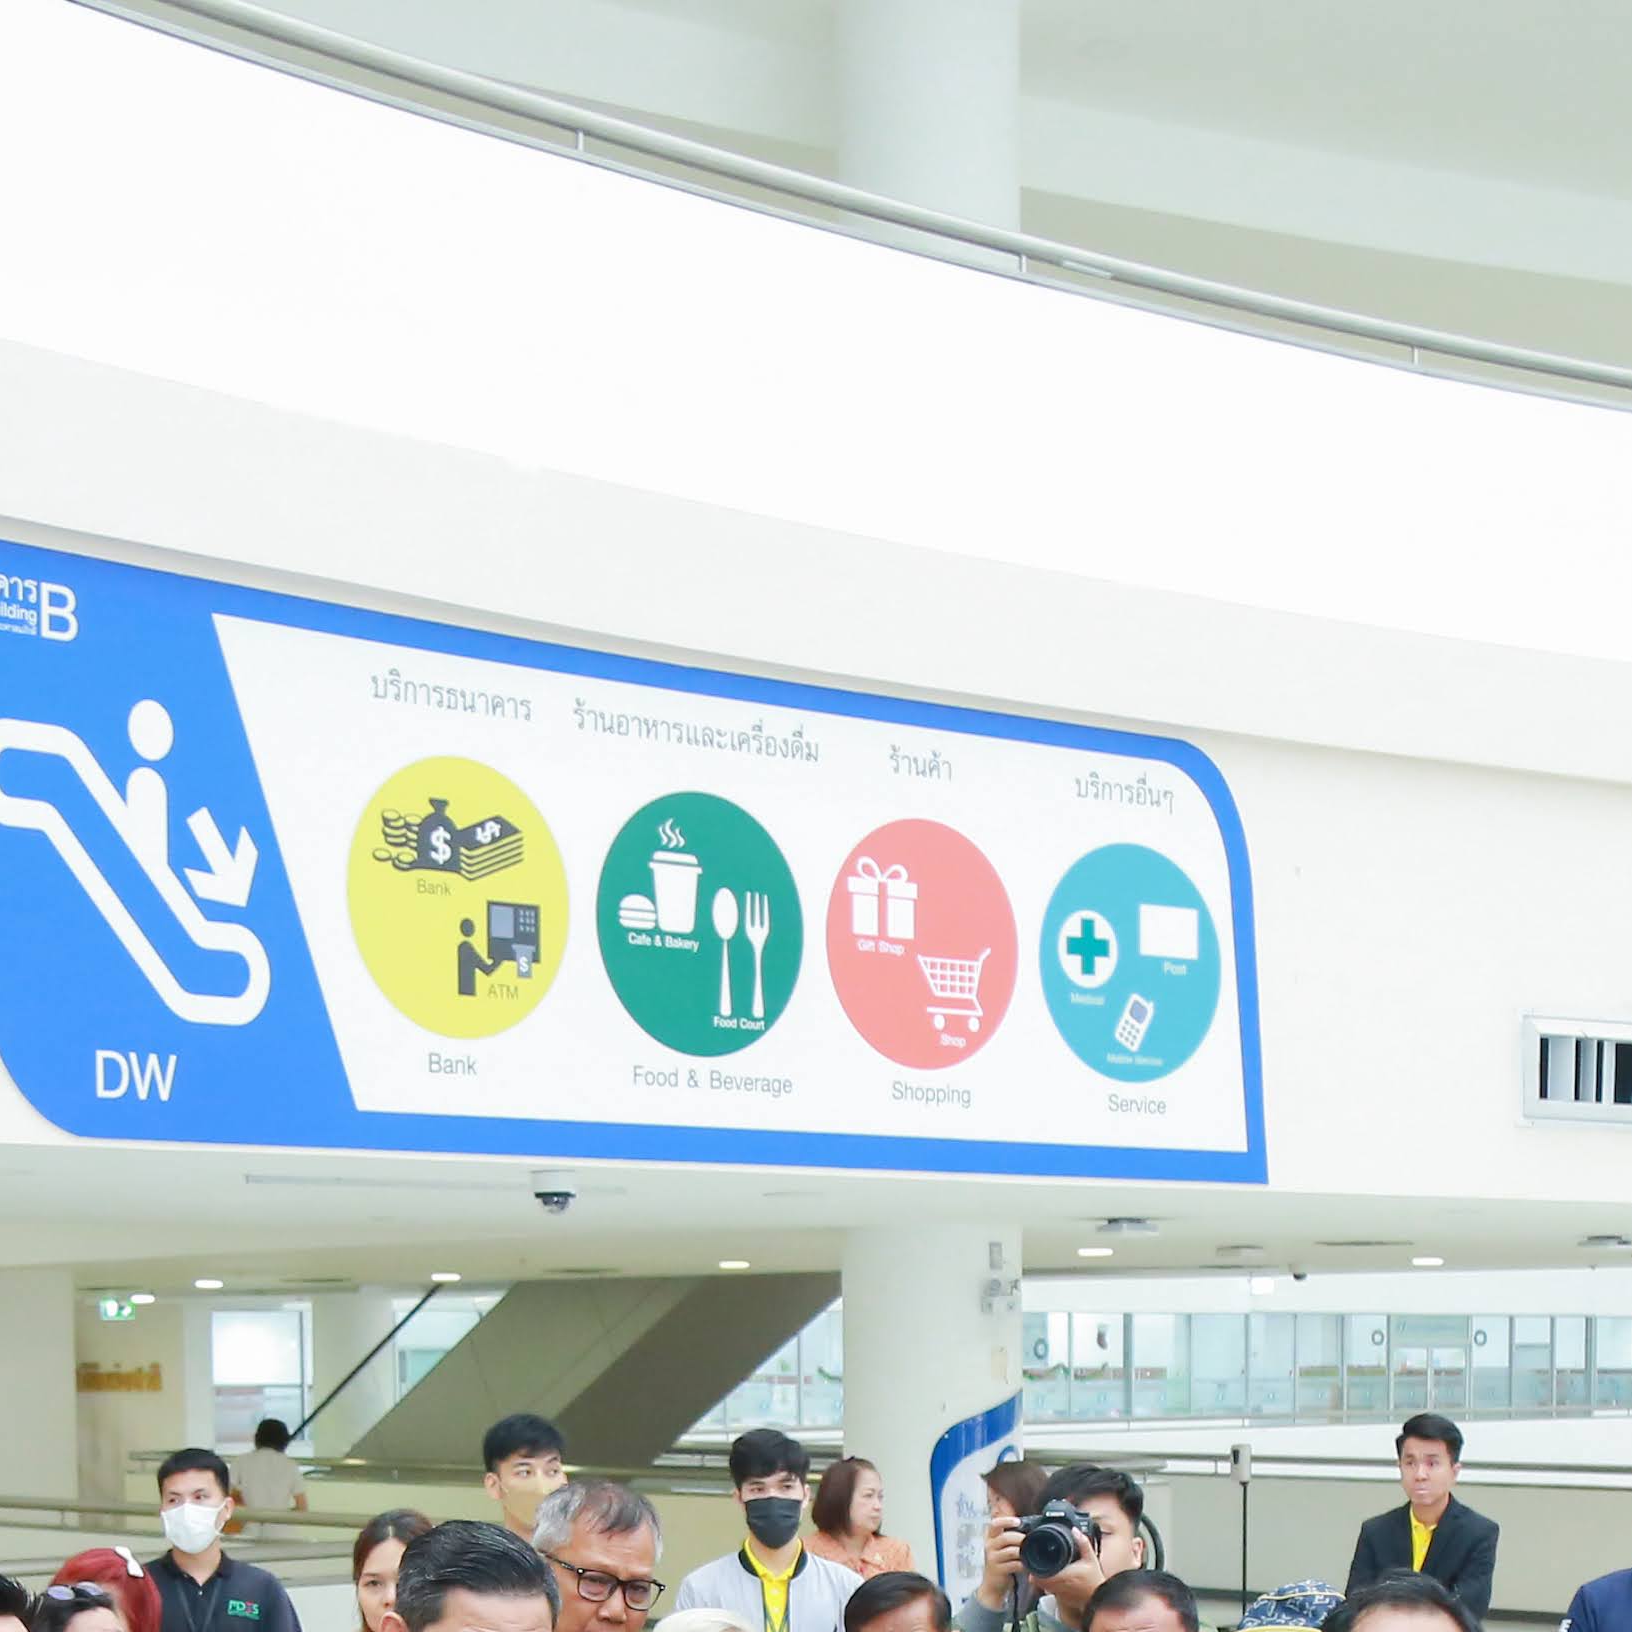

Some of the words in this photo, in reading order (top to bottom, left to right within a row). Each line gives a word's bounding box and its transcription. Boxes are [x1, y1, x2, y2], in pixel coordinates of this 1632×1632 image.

[40, 581, 79, 642] B
[370, 667, 533, 723] บริการธนาคาร
[572, 696, 821, 763] ร้านอาหารและเครื่องดื่ม
[888, 743, 953, 782] ร้านค้า
[1074, 770, 1175, 814] บริการอื่นๆ
[416, 878, 452, 897] Bank
[627, 931, 652, 947] Cafe
[654, 934, 663, 948] &
[664, 935, 700, 953] Bakery
[878, 939, 906, 957] Shop
[486, 982, 520, 1001] ATM
[713, 1015, 737, 1030] Food
[739, 1017, 766, 1031] Court
[939, 1033, 967, 1049] Shop
[95, 1050, 177, 1102] DW
[427, 1052, 478, 1077] Bank
[632, 1064, 679, 1088] Food
[686, 1068, 700, 1089] &
[709, 1069, 794, 1099] Beverage
[891, 1080, 972, 1109] Shopping
[1107, 1093, 1168, 1116] Service
